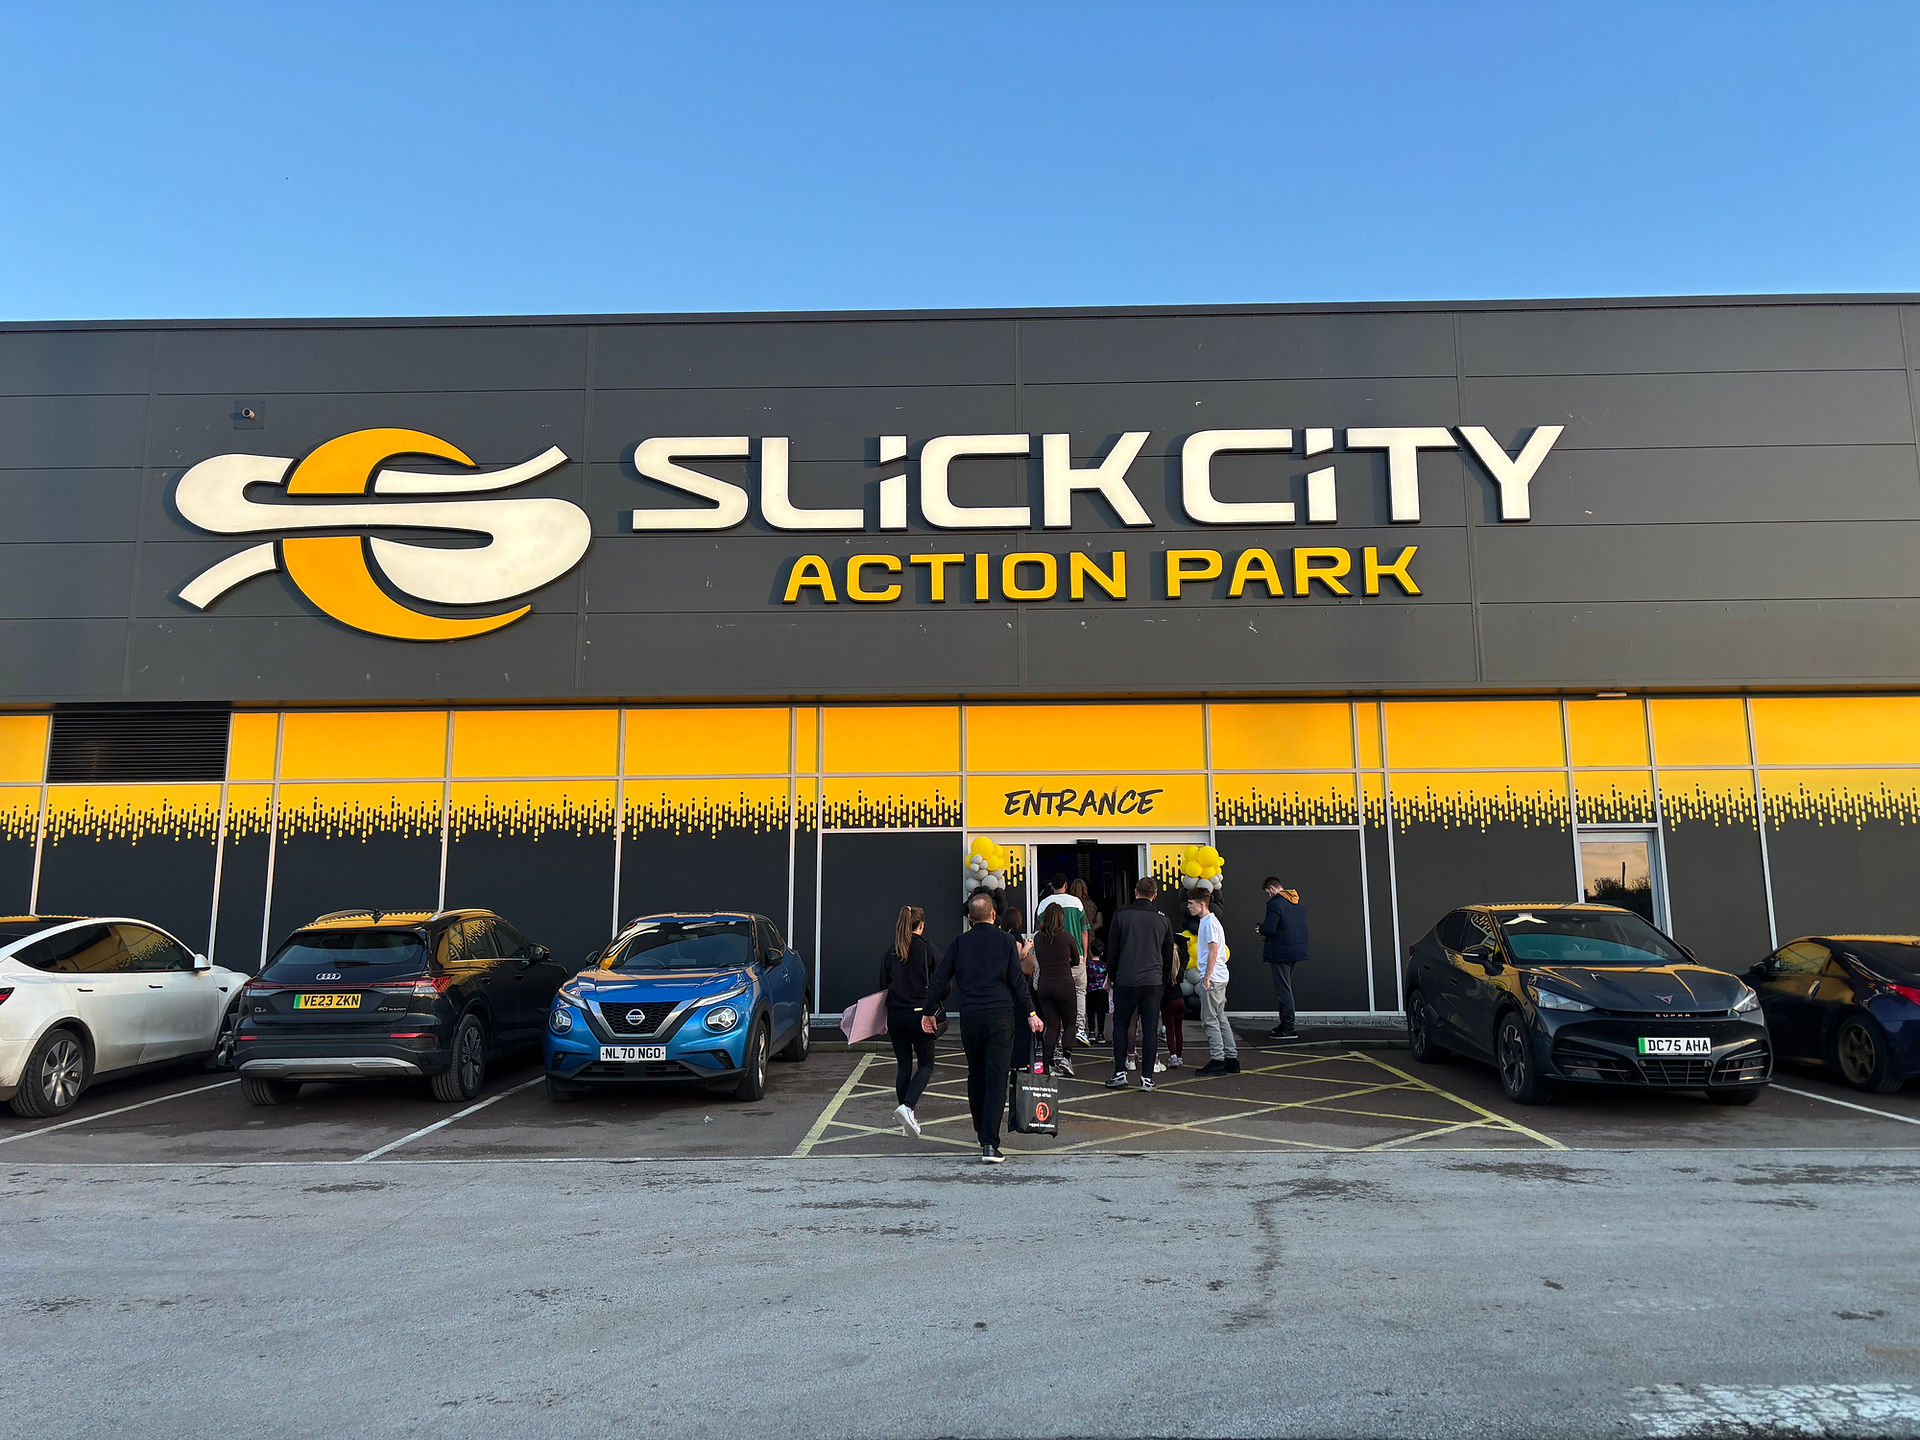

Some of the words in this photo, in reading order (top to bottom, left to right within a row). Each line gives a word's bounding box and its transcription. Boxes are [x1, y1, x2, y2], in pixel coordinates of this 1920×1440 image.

[782, 550, 1128, 603] ACTION
[1165, 545, 1424, 599] PARK
[1004, 786, 1164, 817] ENTRANCE
[303, 995, 333, 1007] VE23
[336, 994, 360, 1006] ZKN
[1647, 1040, 1682, 1051] DC75
[1685, 1040, 1709, 1051] AHA
[638, 1047, 661, 1059] NGO
